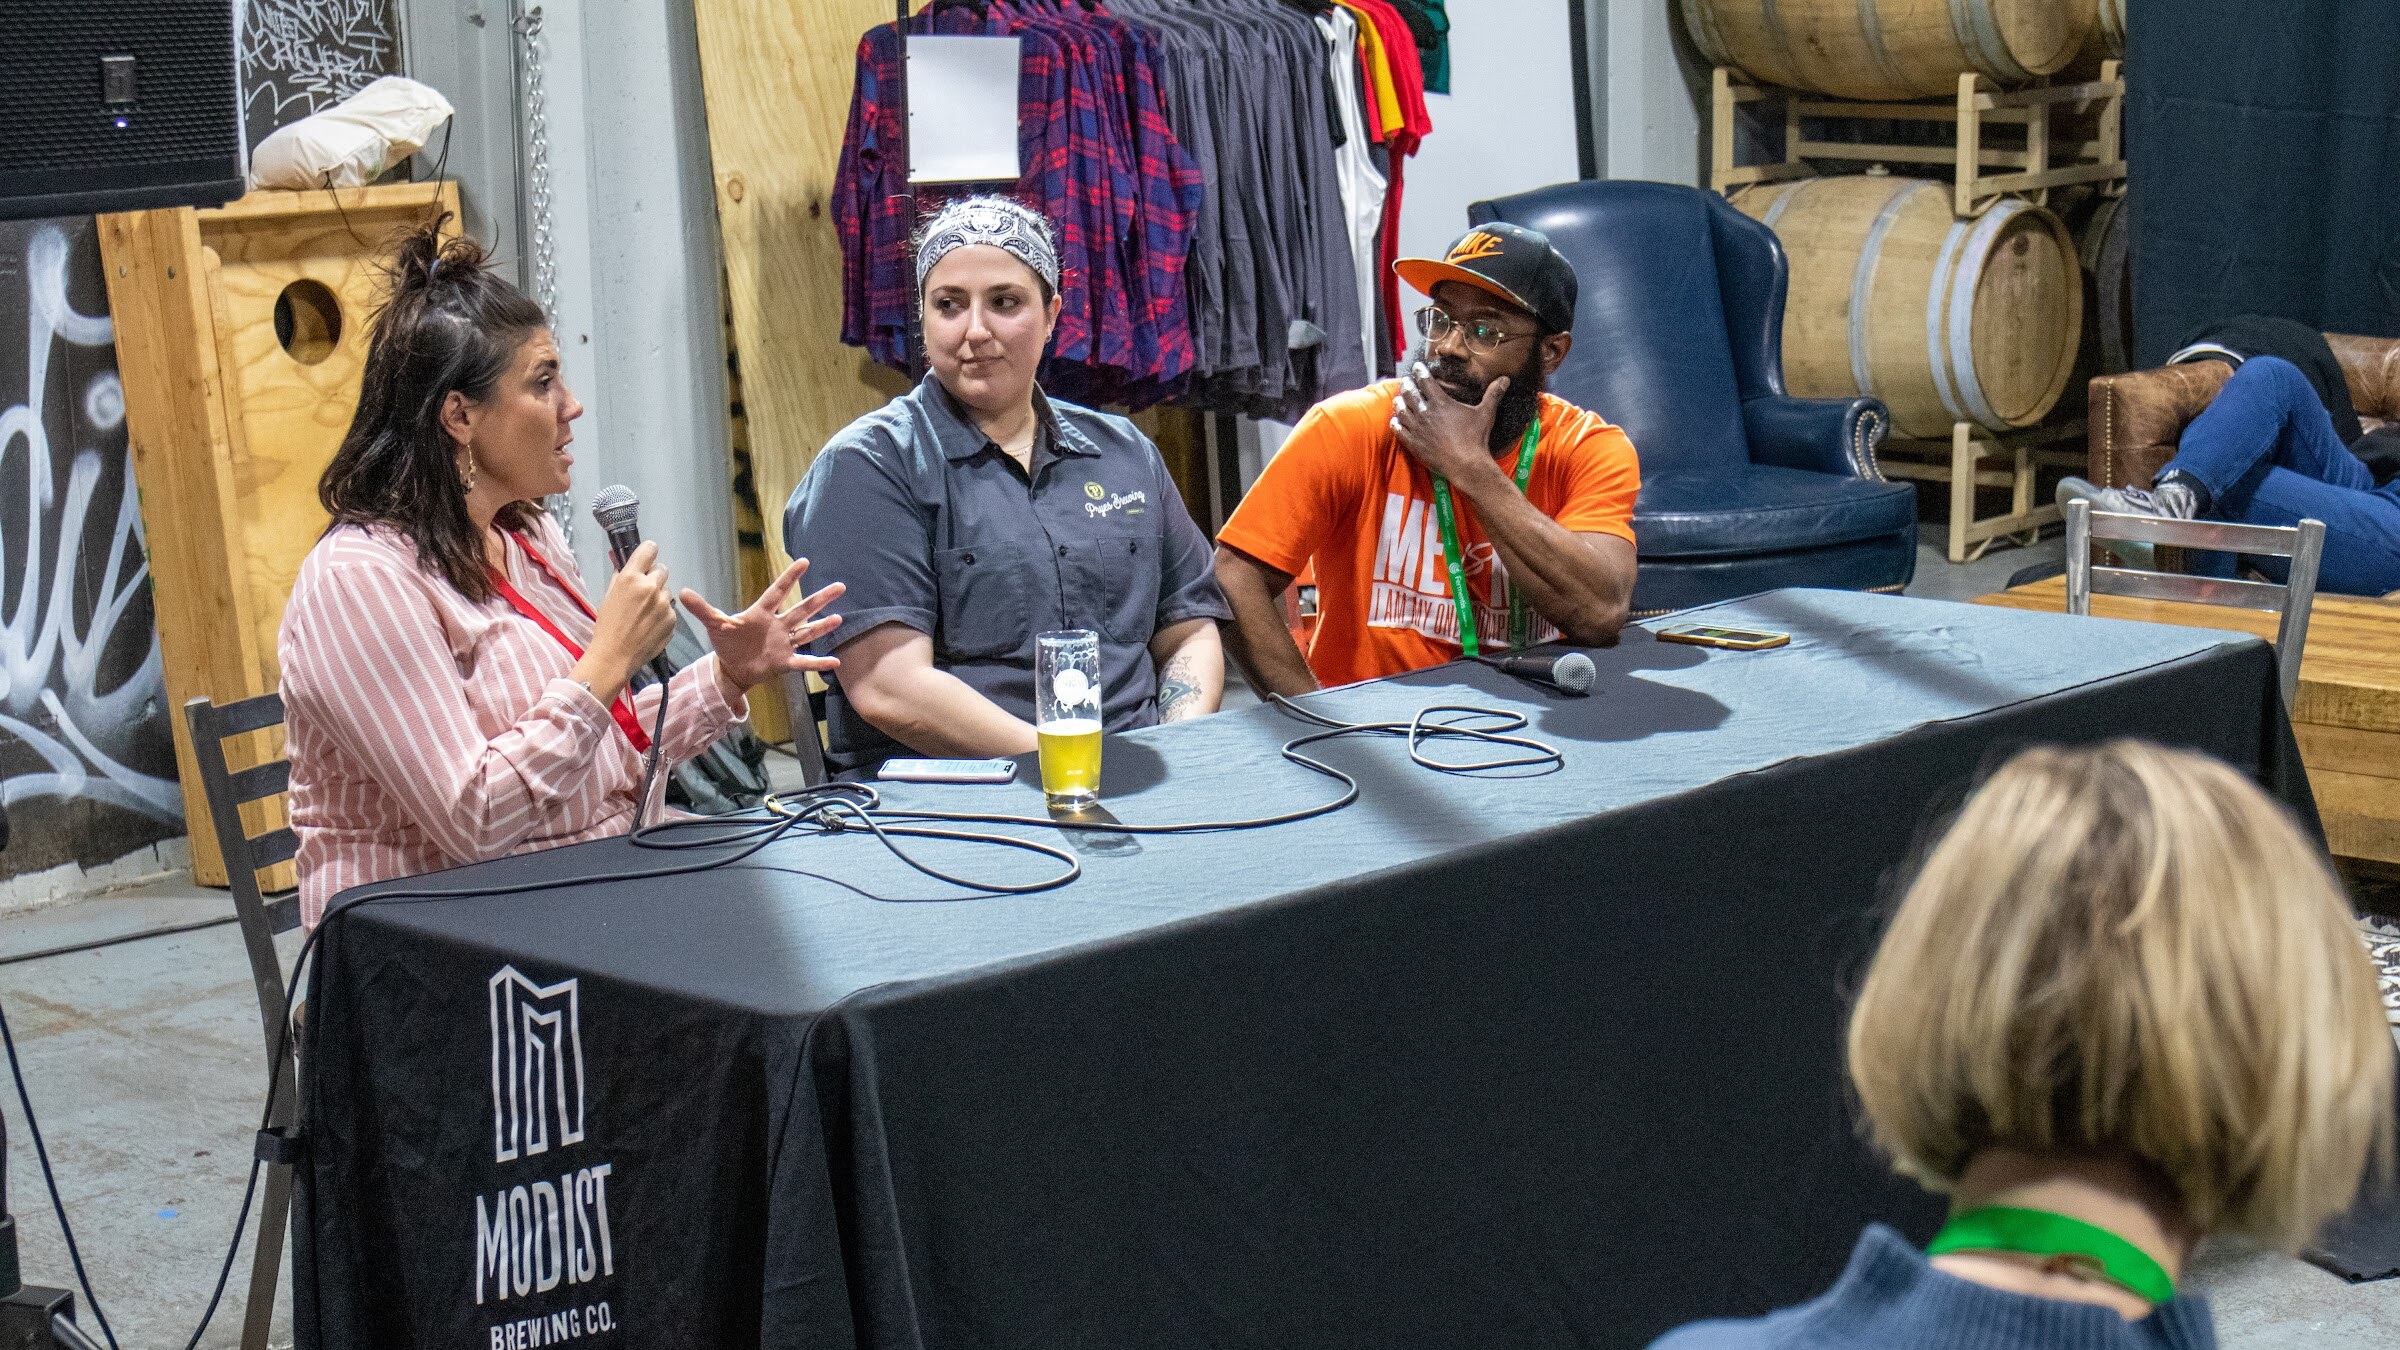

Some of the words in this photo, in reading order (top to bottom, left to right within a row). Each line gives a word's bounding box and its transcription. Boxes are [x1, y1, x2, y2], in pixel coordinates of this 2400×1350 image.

[1453, 232, 1503, 254] NIKE
[1085, 502, 1113, 518] Pryes
[1111, 491, 1145, 510] Brewing
[1373, 492, 1445, 596] ME
[1374, 588, 1380, 621] I
[1384, 589, 1406, 624] AM
[1411, 596, 1432, 631] MY
[1434, 603, 1460, 640] ONL
[476, 1164, 613, 1305] MODIST
[490, 1308, 581, 1350] BREWING
[585, 1302, 616, 1335] CO.
